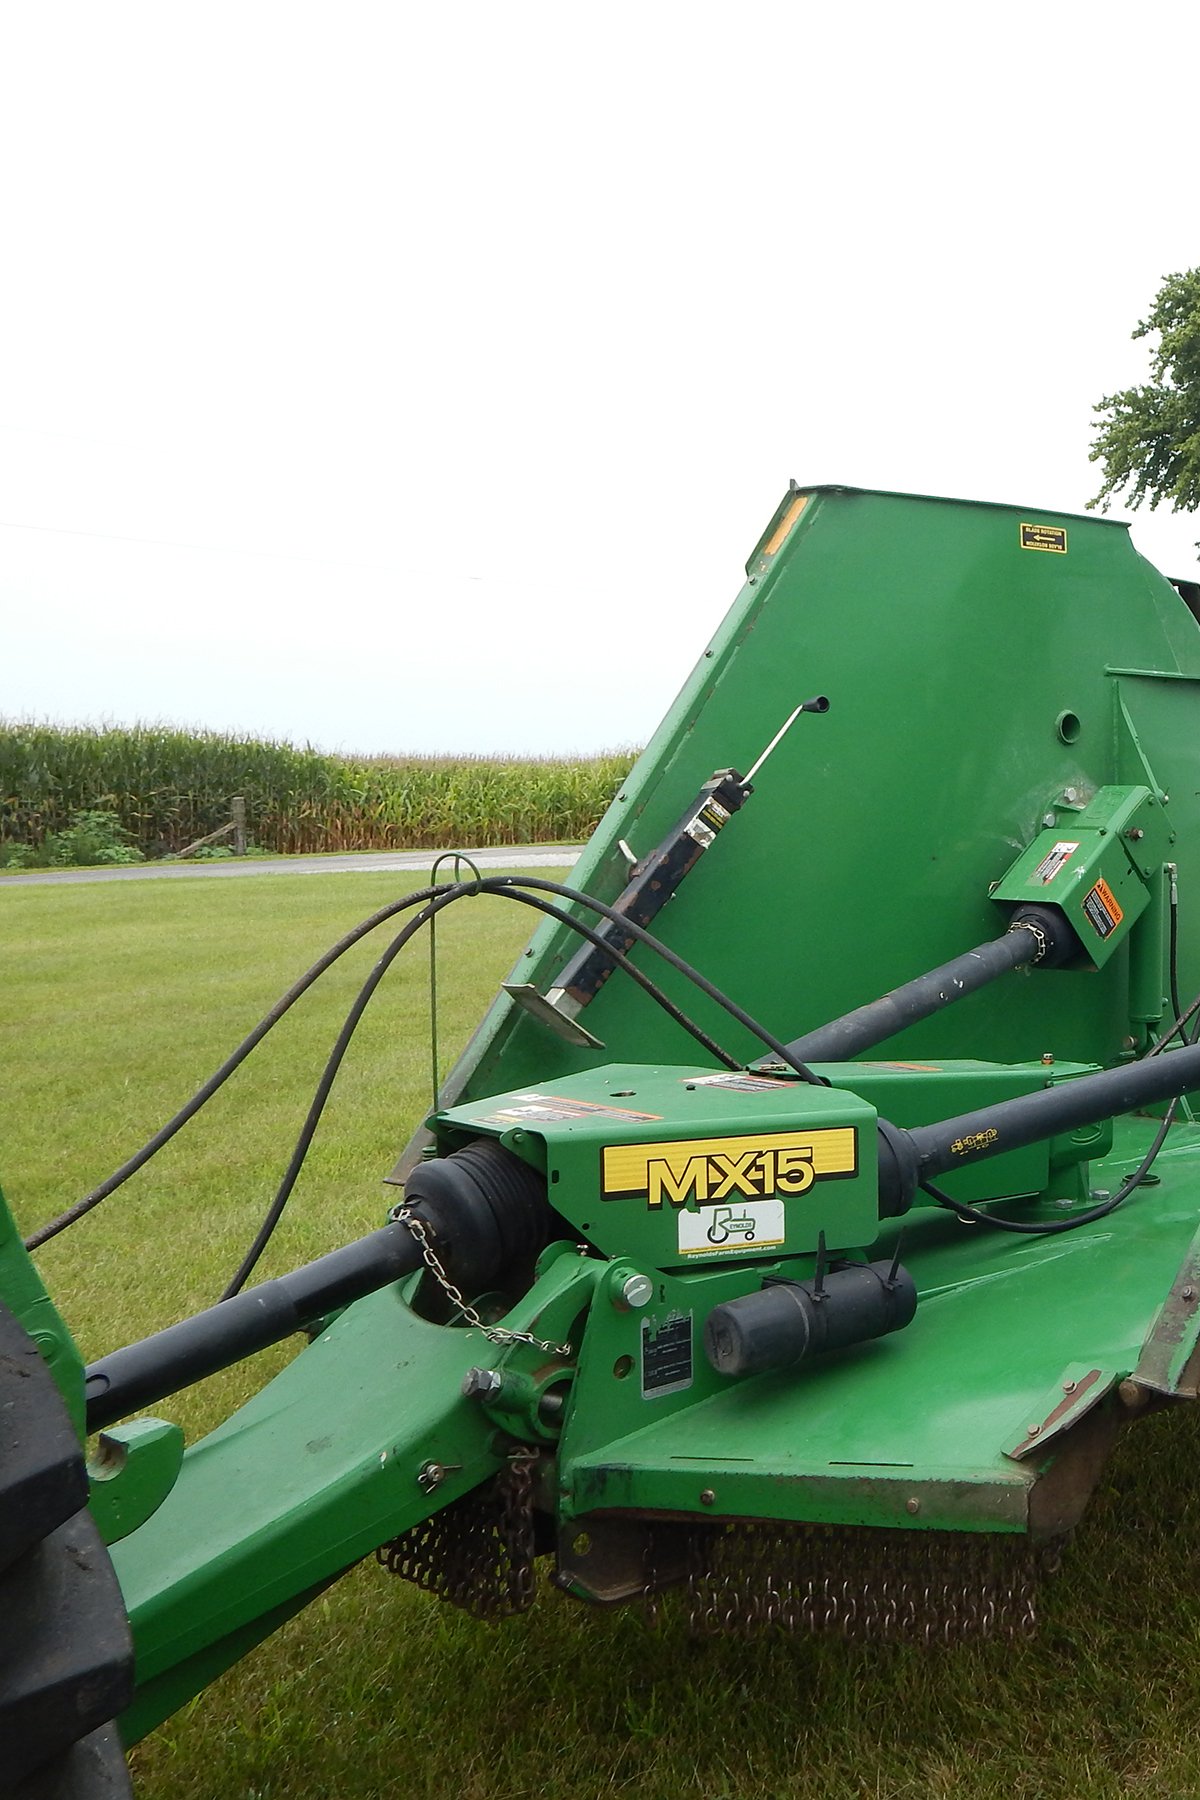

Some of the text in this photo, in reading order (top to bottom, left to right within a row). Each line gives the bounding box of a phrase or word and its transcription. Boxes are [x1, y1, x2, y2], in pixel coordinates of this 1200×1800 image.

[1101, 888, 1121, 921] WARNING
[647, 1147, 815, 1206] MX15
[687, 1245, 777, 1259] ReynoldsFarmEquipment.com
